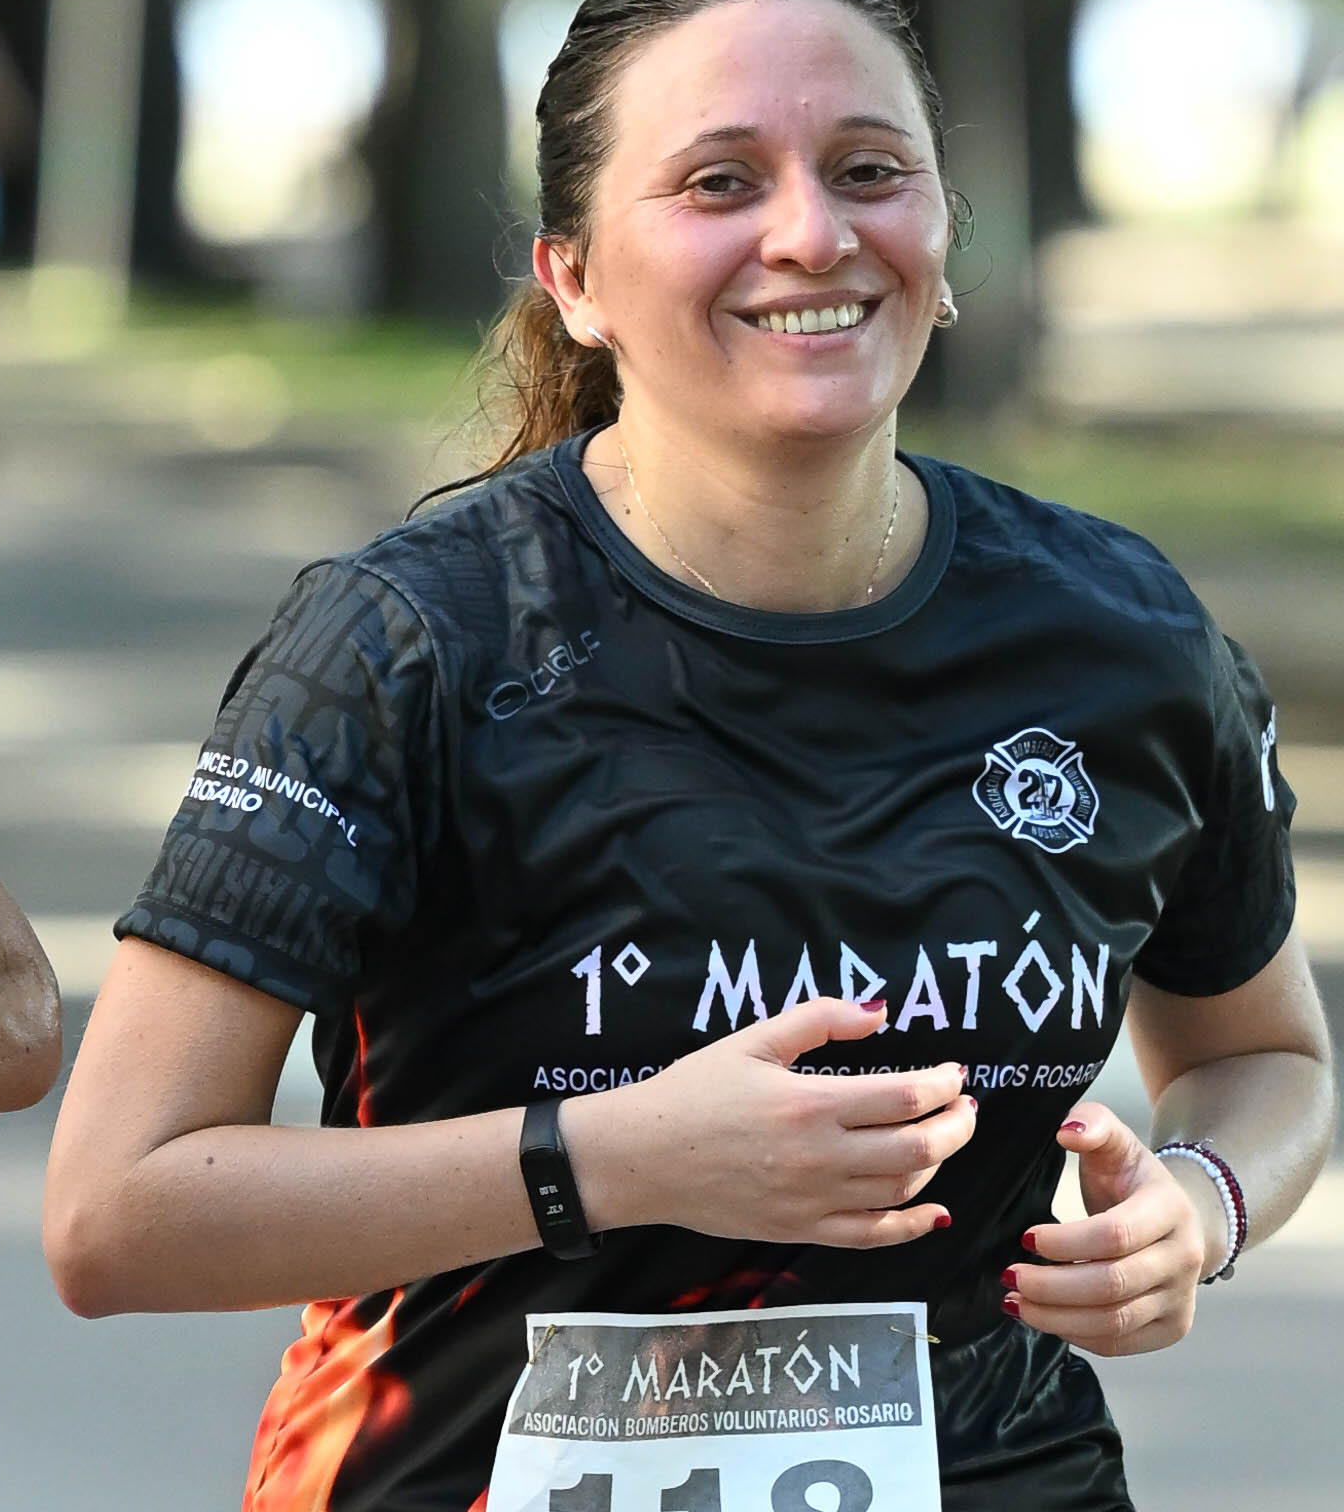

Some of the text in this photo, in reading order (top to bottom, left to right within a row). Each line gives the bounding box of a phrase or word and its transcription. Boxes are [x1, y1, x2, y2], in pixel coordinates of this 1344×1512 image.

[197, 751, 357, 848] NCEJO MUNICIPAL
[692, 910, 1110, 1034] MARATÓN
[621, 1329, 861, 1403] MARATÓN
[523, 1402, 913, 1437] ASOCIACIÓN BOMBEROS VOLUNTARIOS ROSARIO
